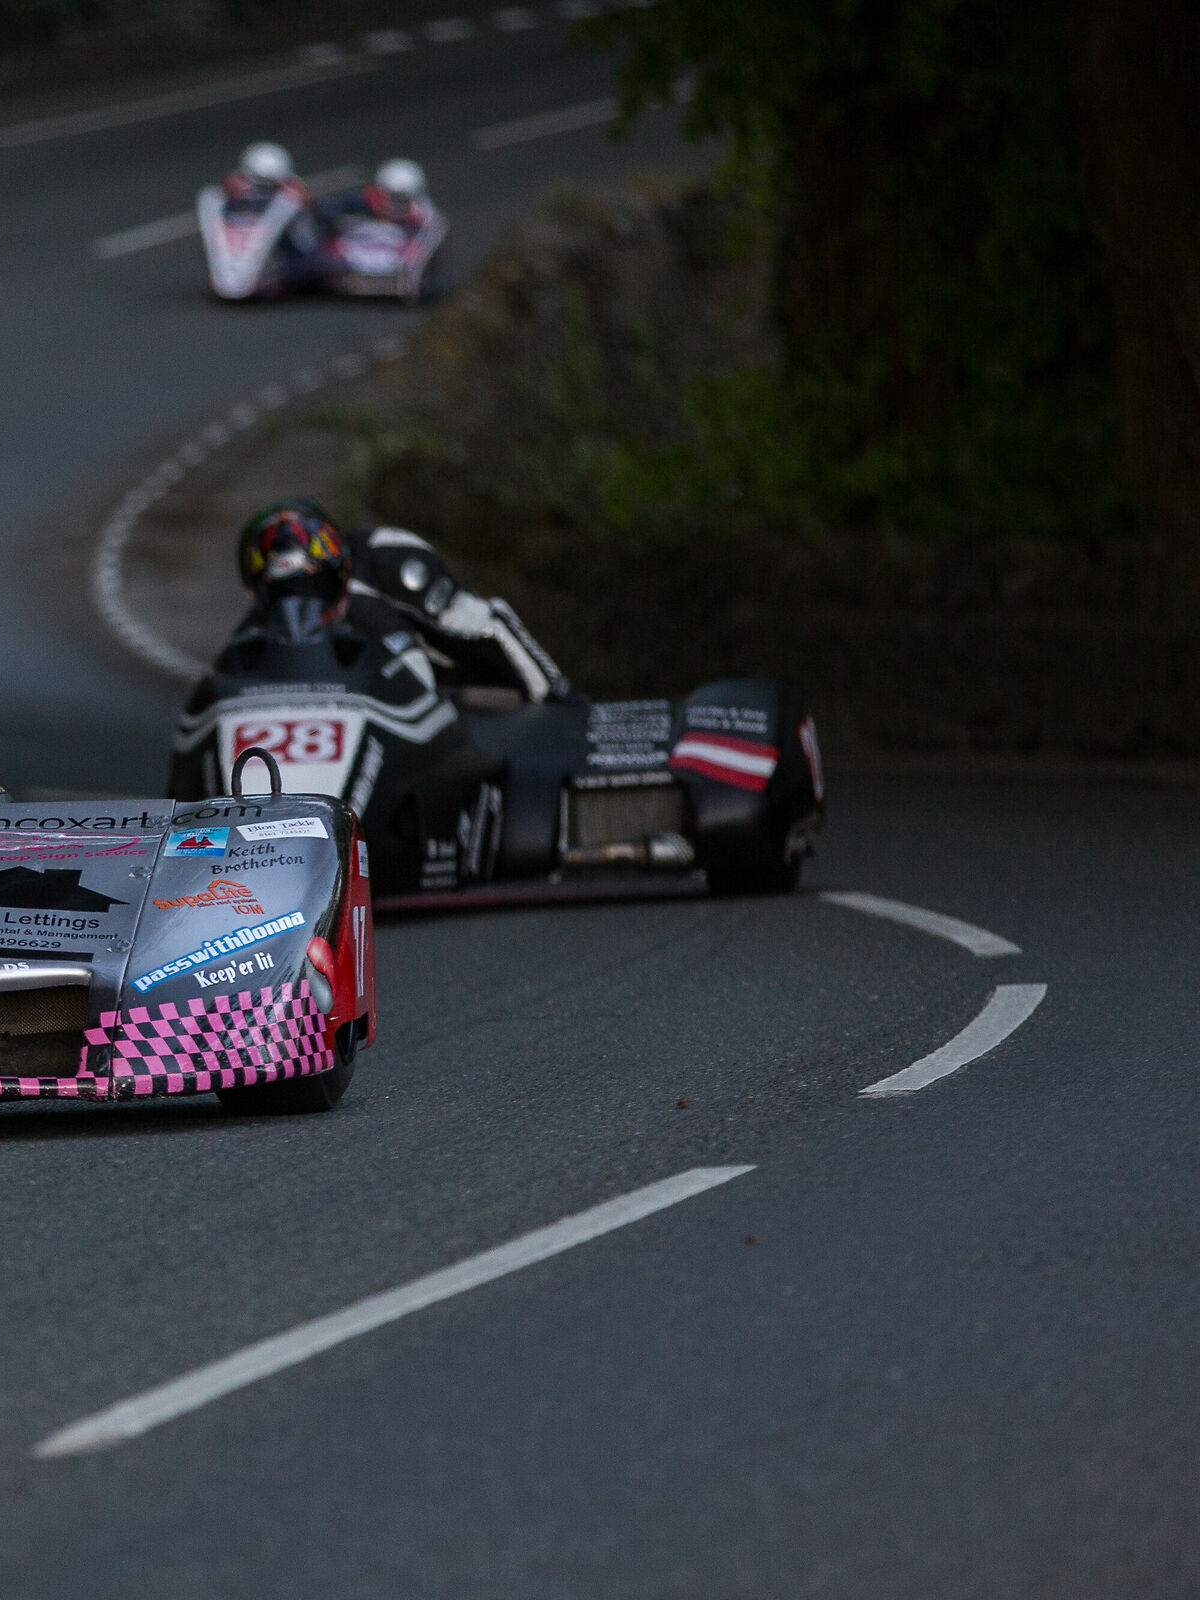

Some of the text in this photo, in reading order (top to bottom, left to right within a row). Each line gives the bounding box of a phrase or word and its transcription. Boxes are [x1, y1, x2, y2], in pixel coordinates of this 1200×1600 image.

[239, 720, 336, 763] 28
[247, 820, 316, 833] Elton Tackle
[32, 851, 80, 862] Sign
[85, 849, 148, 857] Service
[228, 842, 276, 858] Keith
[211, 854, 306, 875] Brotherton
[232, 904, 265, 914] IOM
[4, 911, 100, 931] Lettings
[36, 929, 119, 940] Management
[133, 911, 306, 991] passwithDonna
[193, 952, 275, 989] Keep'er lit
